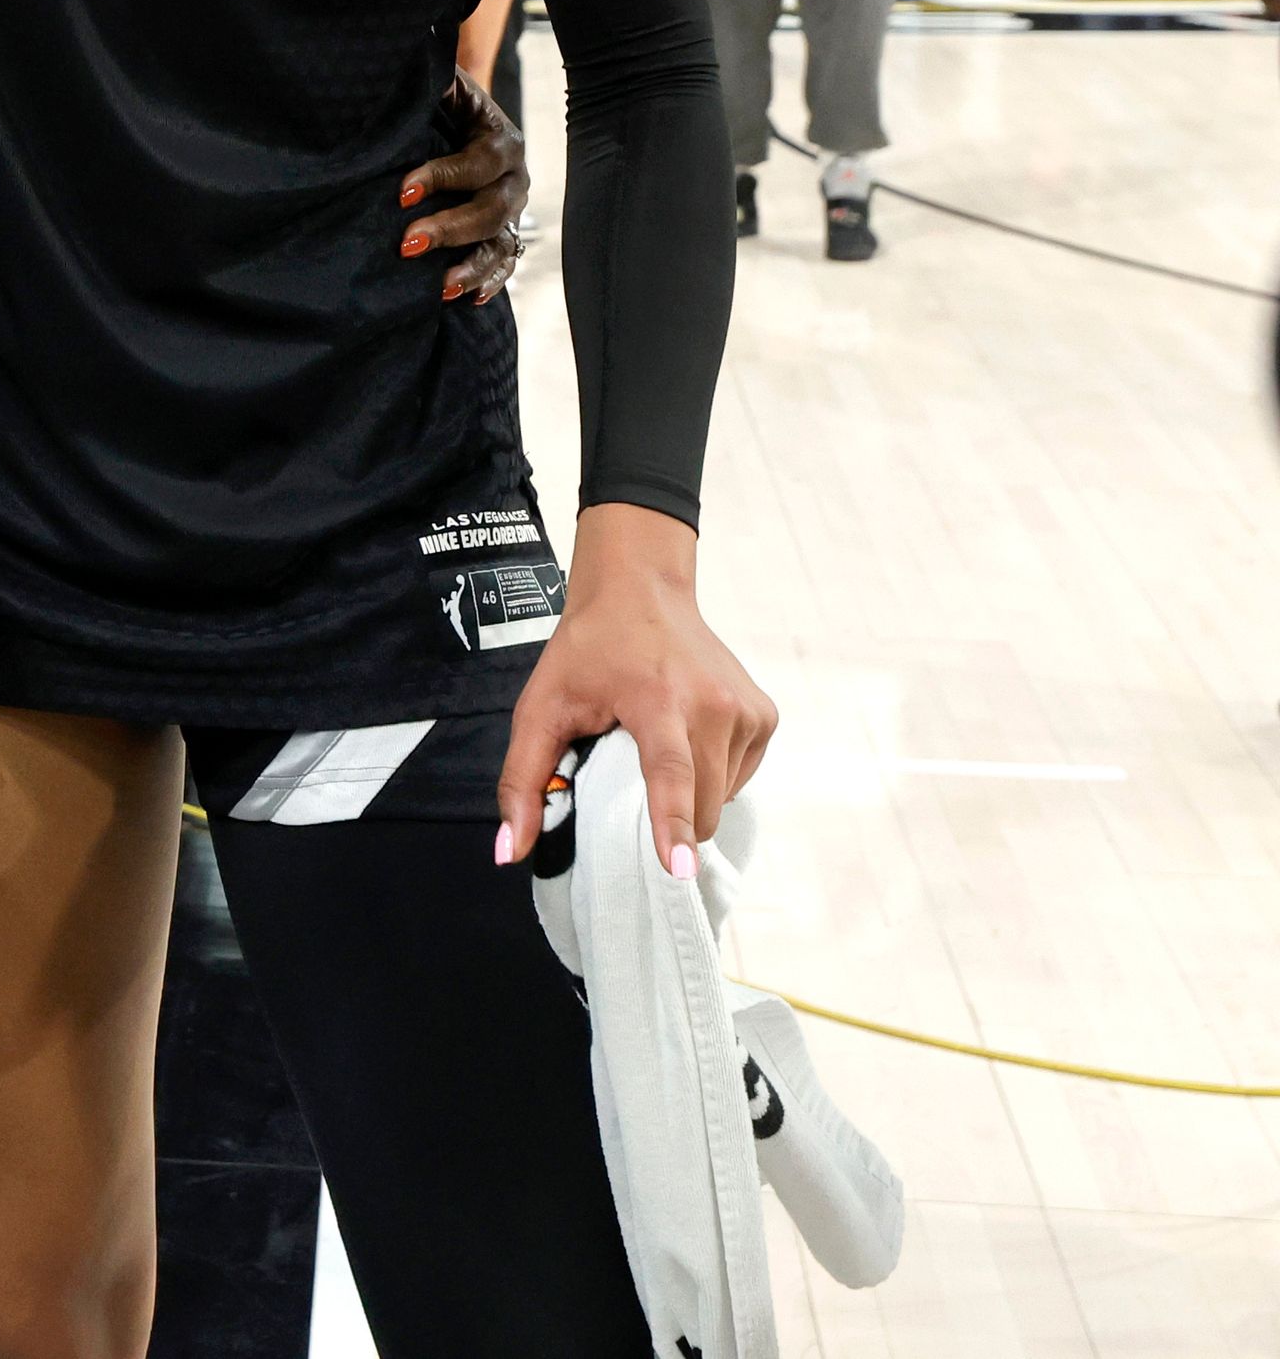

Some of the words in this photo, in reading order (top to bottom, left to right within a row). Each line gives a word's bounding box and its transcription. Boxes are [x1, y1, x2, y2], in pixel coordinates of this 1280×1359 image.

[431, 513, 471, 531] LAS
[471, 509, 510, 525] VEGAS
[419, 530, 460, 555] NIKE
[460, 525, 518, 549] EXPLORER
[482, 590, 497, 605] 46
